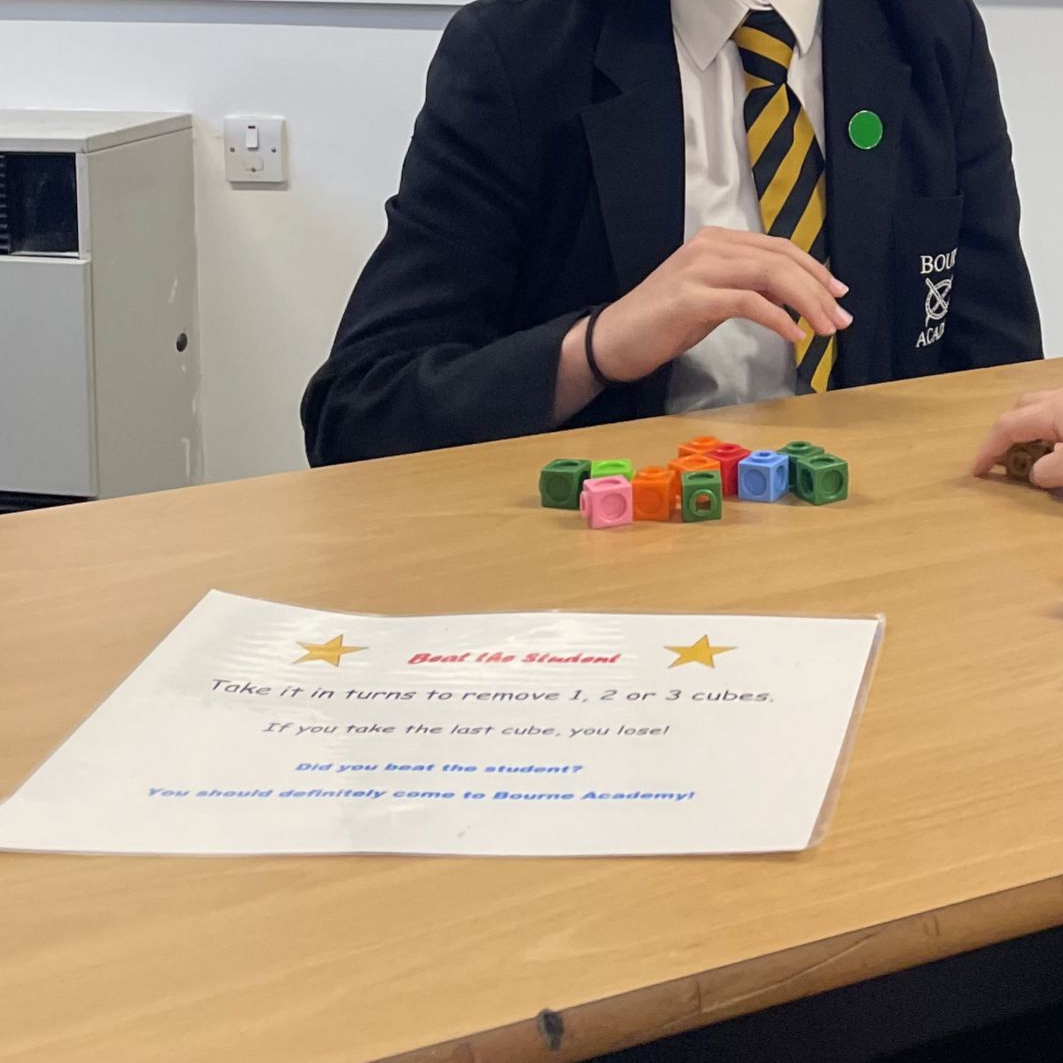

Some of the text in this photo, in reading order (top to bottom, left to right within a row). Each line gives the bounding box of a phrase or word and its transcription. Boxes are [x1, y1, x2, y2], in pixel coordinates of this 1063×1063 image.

[920, 247, 957, 273] BOU
[408, 651, 622, 665] Beat the Student
[210, 678, 271, 697] Take
[280, 685, 304, 698] it
[310, 687, 334, 699] in
[346, 688, 416, 701] turns
[426, 689, 452, 701] to
[460, 691, 560, 701] remove
[600, 689, 618, 701] 2
[626, 691, 656, 701] or
[665, 689, 682, 701] 3
[692, 690, 775, 703] cubes.
[262, 722, 294, 733] If
[295, 725, 338, 735] you
[346, 723, 396, 735] take
[405, 724, 442, 735] the
[450, 724, 495, 735] last
[501, 725, 562, 737] cube,
[568, 727, 608, 737] you
[294, 763, 584, 773] Did you beat the student?
[148, 787, 696, 801] You should definitely come to Bourne Academy!
